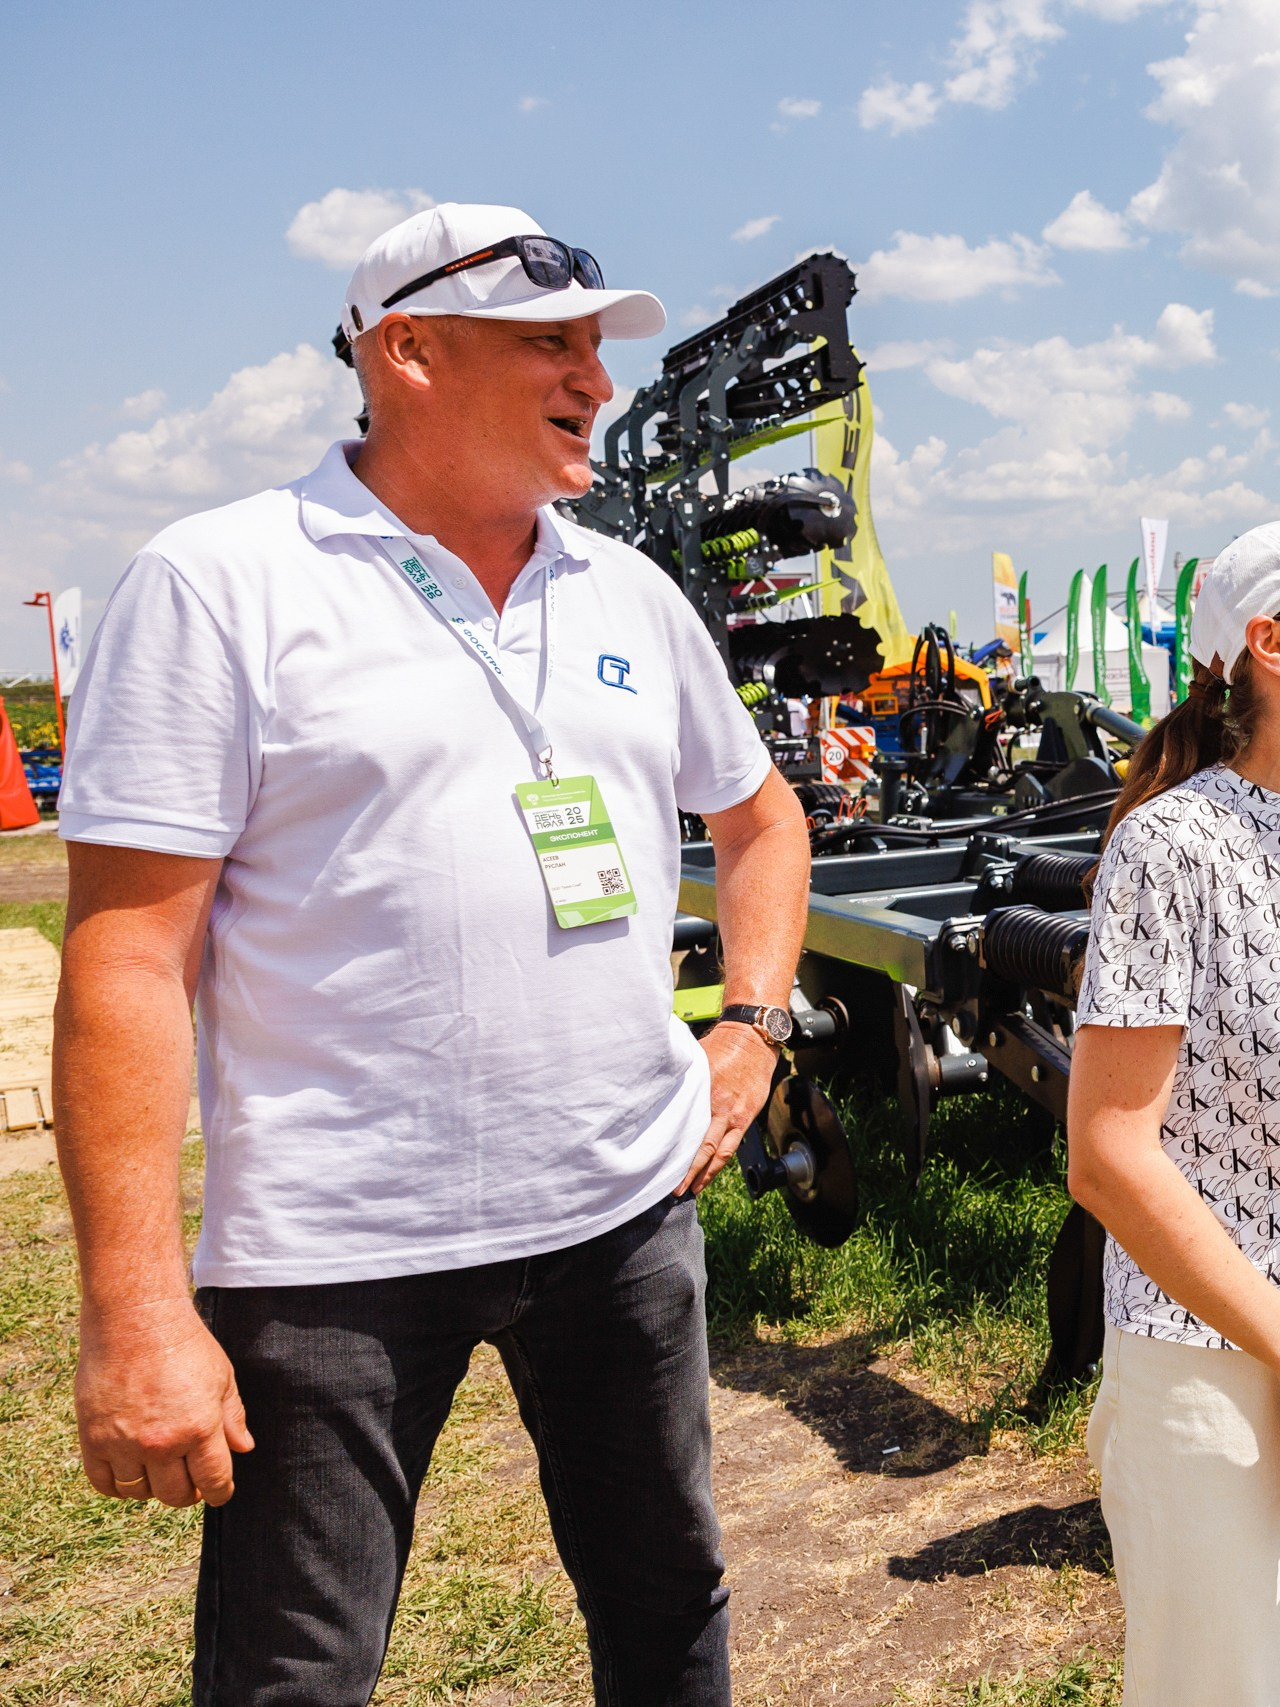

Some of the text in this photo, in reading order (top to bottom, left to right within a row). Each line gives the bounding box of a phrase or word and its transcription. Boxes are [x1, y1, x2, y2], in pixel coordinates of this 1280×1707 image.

[407, 558, 427, 581] ДЕНЬ
[421, 586, 436, 600] 25
[429, 582, 443, 597] 20
[463, 627, 502, 676] ФОСАГРО
[829, 751, 842, 761] 20
[565, 806, 581, 816] 20
[534, 813, 562, 823] ДЕНЬ
[568, 815, 585, 825] 25
[535, 819, 565, 830] ПОЛЯ
[549, 828, 599, 843] ЭКСПОНЕНТ
